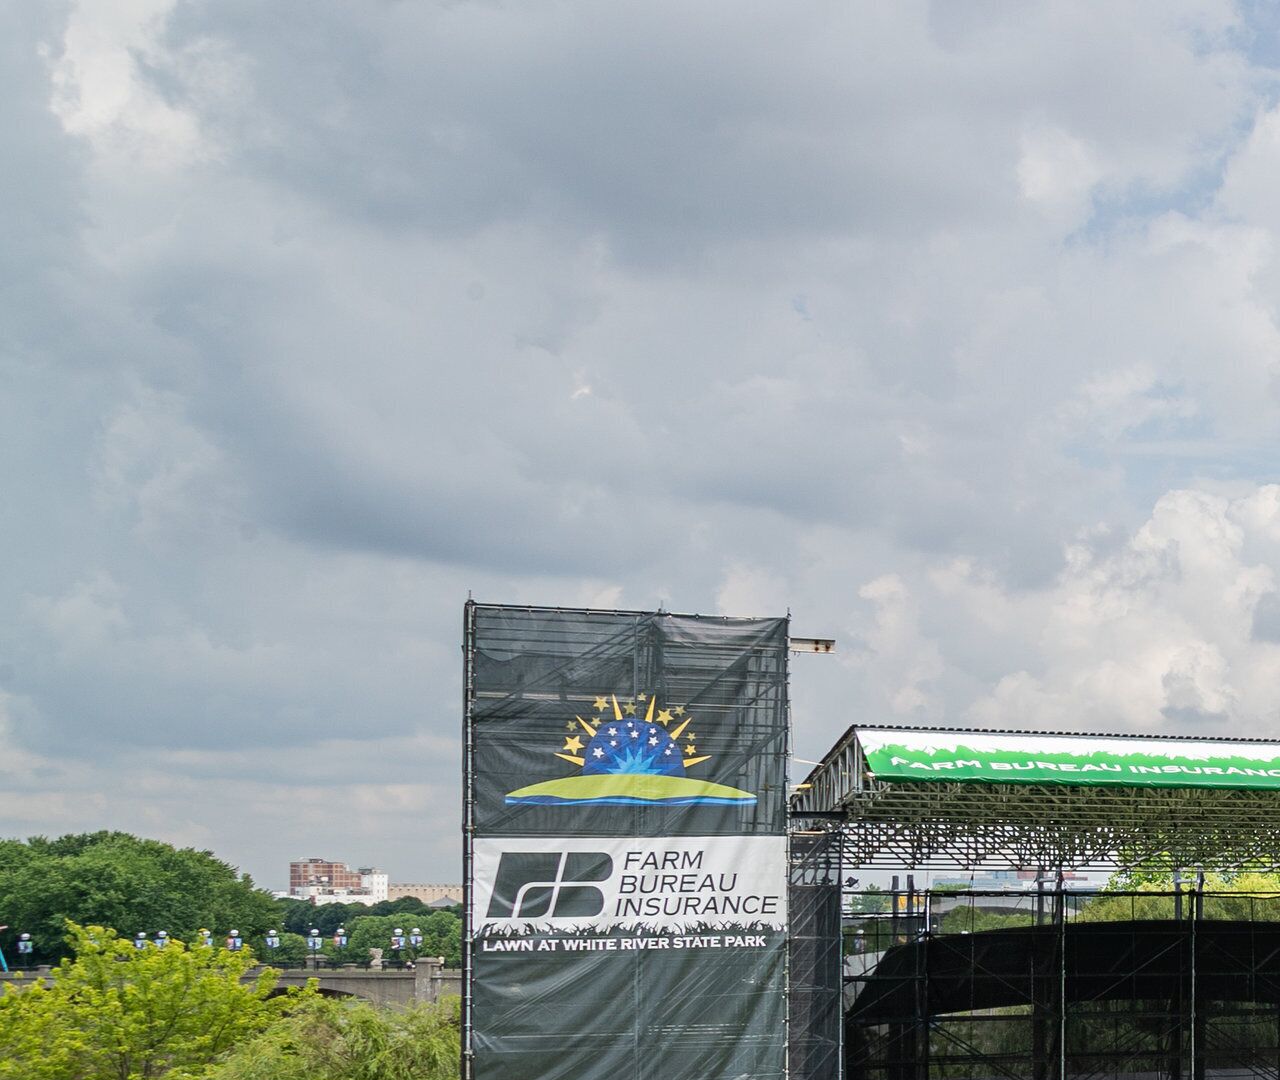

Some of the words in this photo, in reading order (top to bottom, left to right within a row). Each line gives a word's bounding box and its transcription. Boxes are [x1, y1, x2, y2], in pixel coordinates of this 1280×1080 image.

[890, 756, 982, 771] FARM
[990, 761, 1122, 772] BUREAU
[623, 850, 705, 871] FARM
[619, 872, 738, 894] BUREAU
[615, 896, 779, 917] INSURANCE
[483, 939, 534, 952] LAWN
[537, 939, 560, 951] AT
[562, 938, 617, 951] WHITE
[620, 937, 670, 950] RIVER
[673, 936, 721, 949] STATE
[724, 935, 767, 948] PARK
